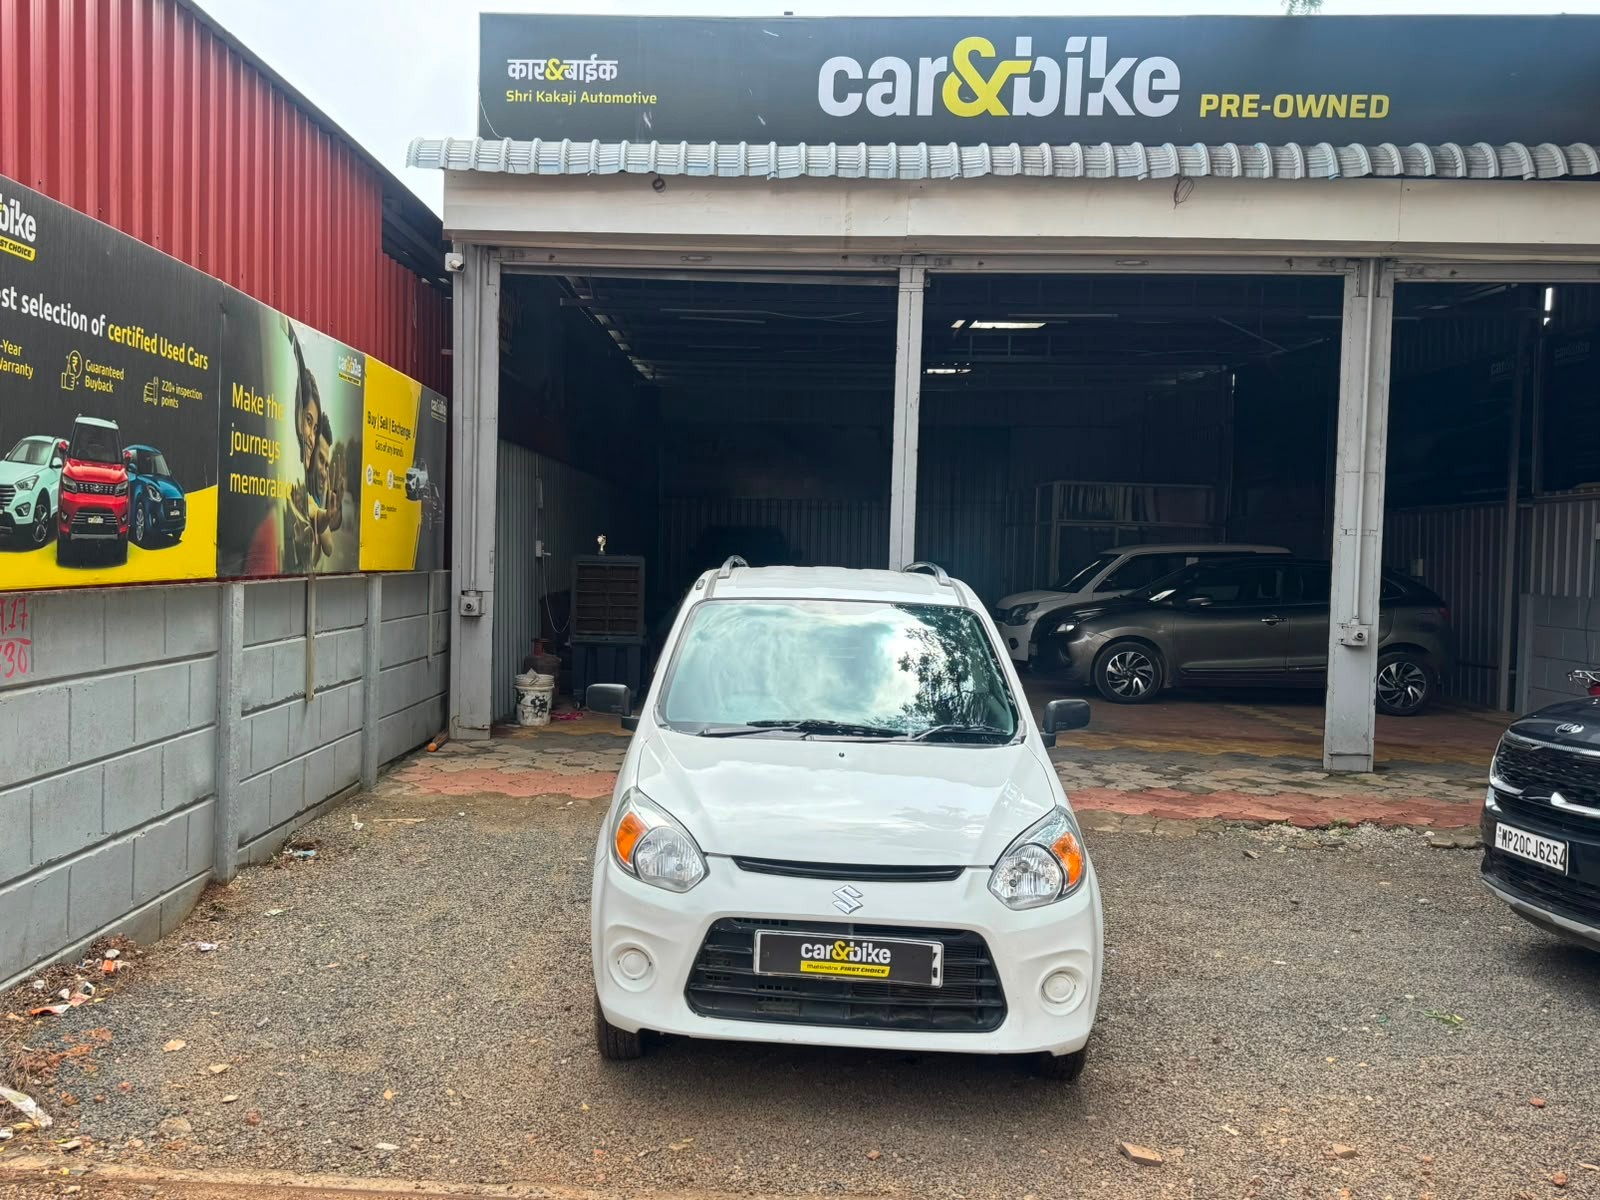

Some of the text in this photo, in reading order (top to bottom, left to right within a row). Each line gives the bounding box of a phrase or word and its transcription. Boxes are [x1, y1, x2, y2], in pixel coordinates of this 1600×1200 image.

[507, 54, 618, 83] कार&बाईक
[818, 36, 1180, 117] car&bike
[506, 90, 657, 105] Shri Kakaji Automotive
[1200, 94, 1390, 118] PRE-OWNED
[9, 243, 32, 257] CHOICE
[0, 286, 208, 370] st selection of certified Used Cars
[85, 359, 124, 380] Guaranteed
[85, 375, 113, 393] Buyback
[162, 380, 202, 400] 220+ inspection
[161, 396, 179, 408] points
[232, 382, 264, 416] Make
[368, 411, 377, 429] Buy
[230, 422, 281, 464] journeys
[1502, 828, 1566, 866] MP20CJ6254
[801, 940, 891, 964] car&bike
